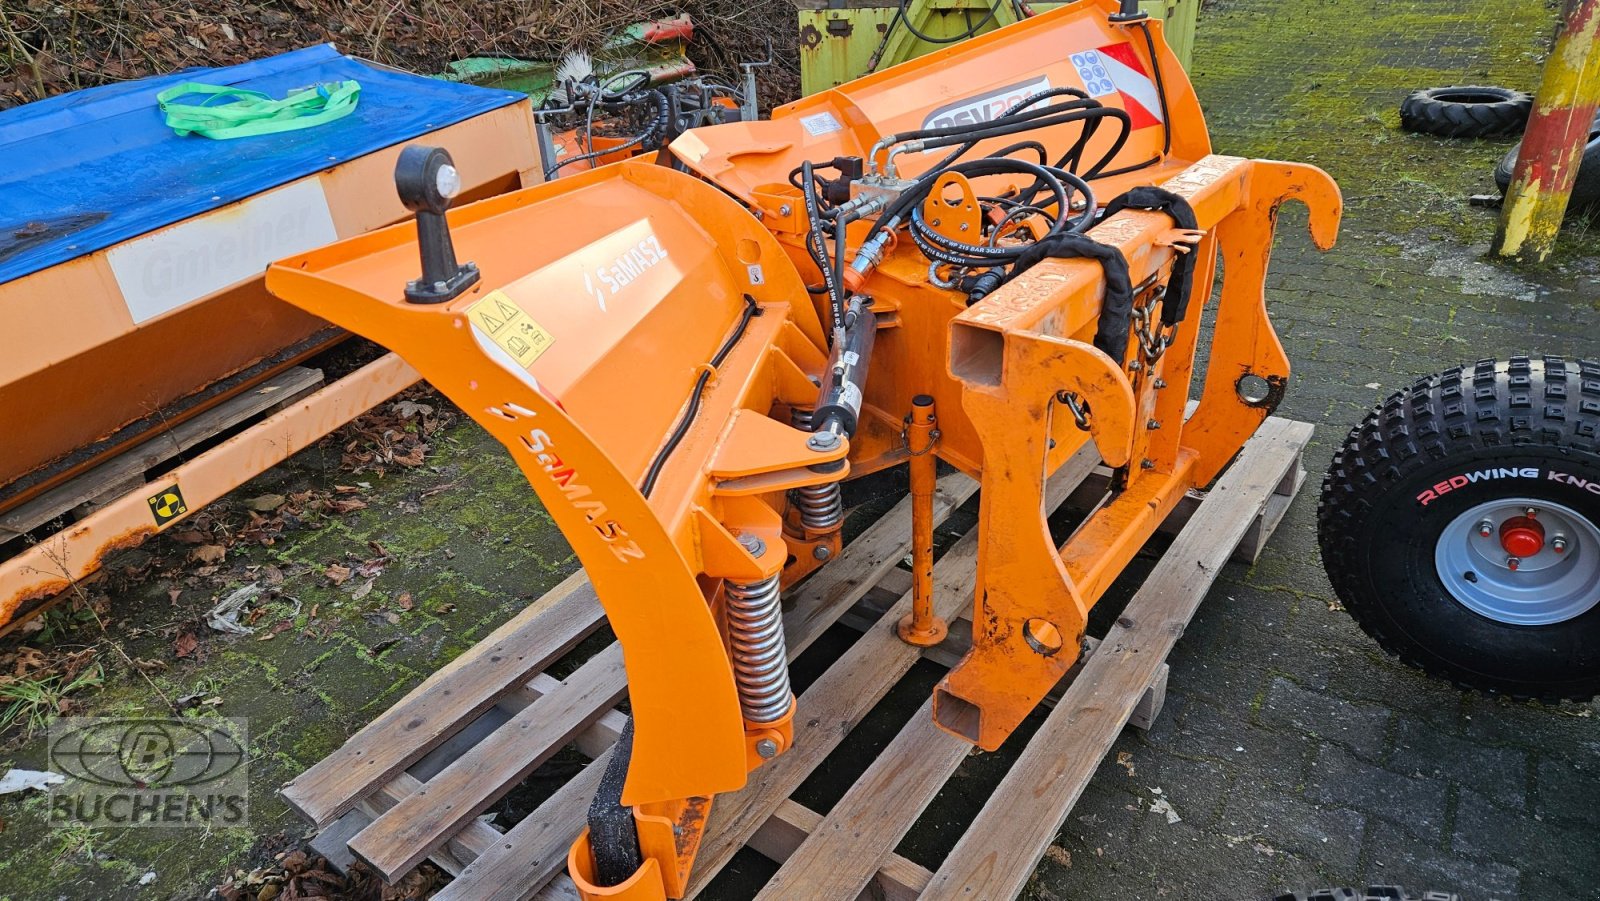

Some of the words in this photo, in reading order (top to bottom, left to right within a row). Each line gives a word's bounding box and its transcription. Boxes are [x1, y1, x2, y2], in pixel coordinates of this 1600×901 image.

[142, 204, 312, 298] Gmeiner
[596, 234, 668, 294] SaMASZ
[810, 217, 818, 232] SAE
[823, 267, 830, 277] EN
[832, 303, 839, 313] DN
[935, 251, 948, 260] BAR
